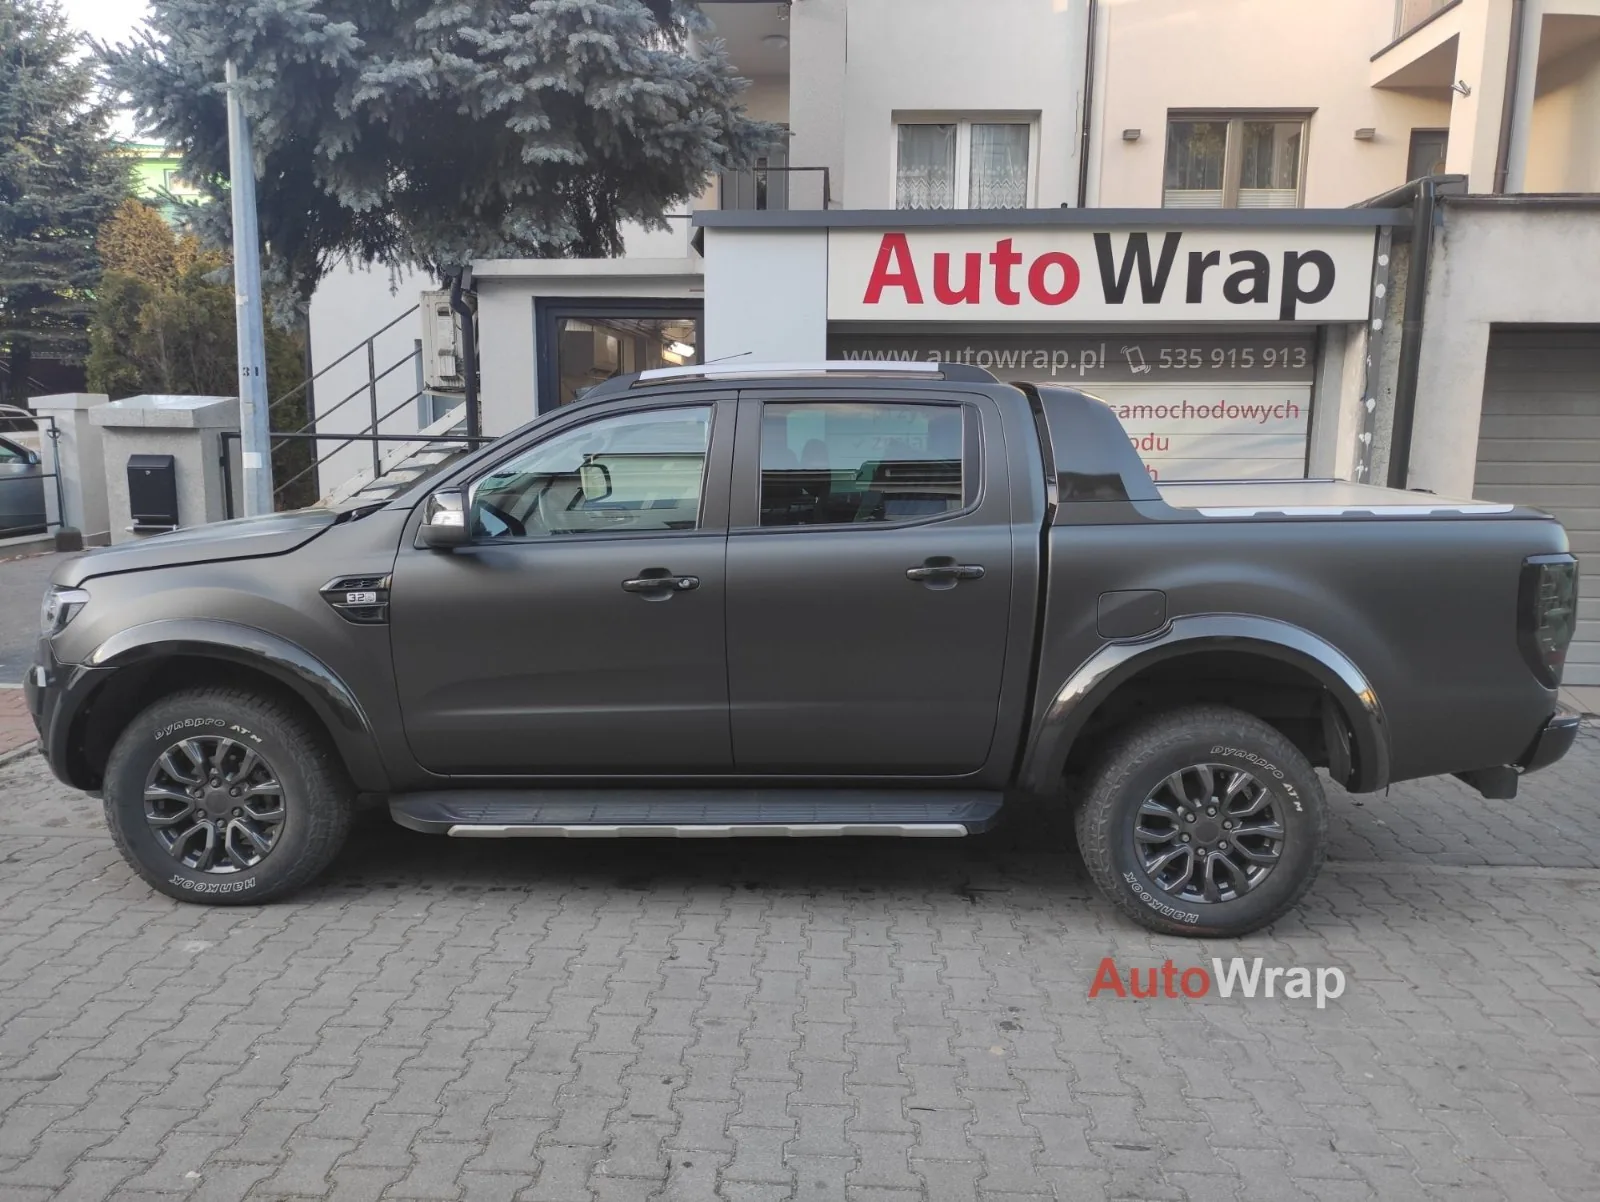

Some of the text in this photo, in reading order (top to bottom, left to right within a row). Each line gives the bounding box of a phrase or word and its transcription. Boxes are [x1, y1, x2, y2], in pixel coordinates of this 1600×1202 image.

[841, 343, 1307, 376] wwwautowrap.pl 535 915 913
[1129, 432, 1169, 451] odu
